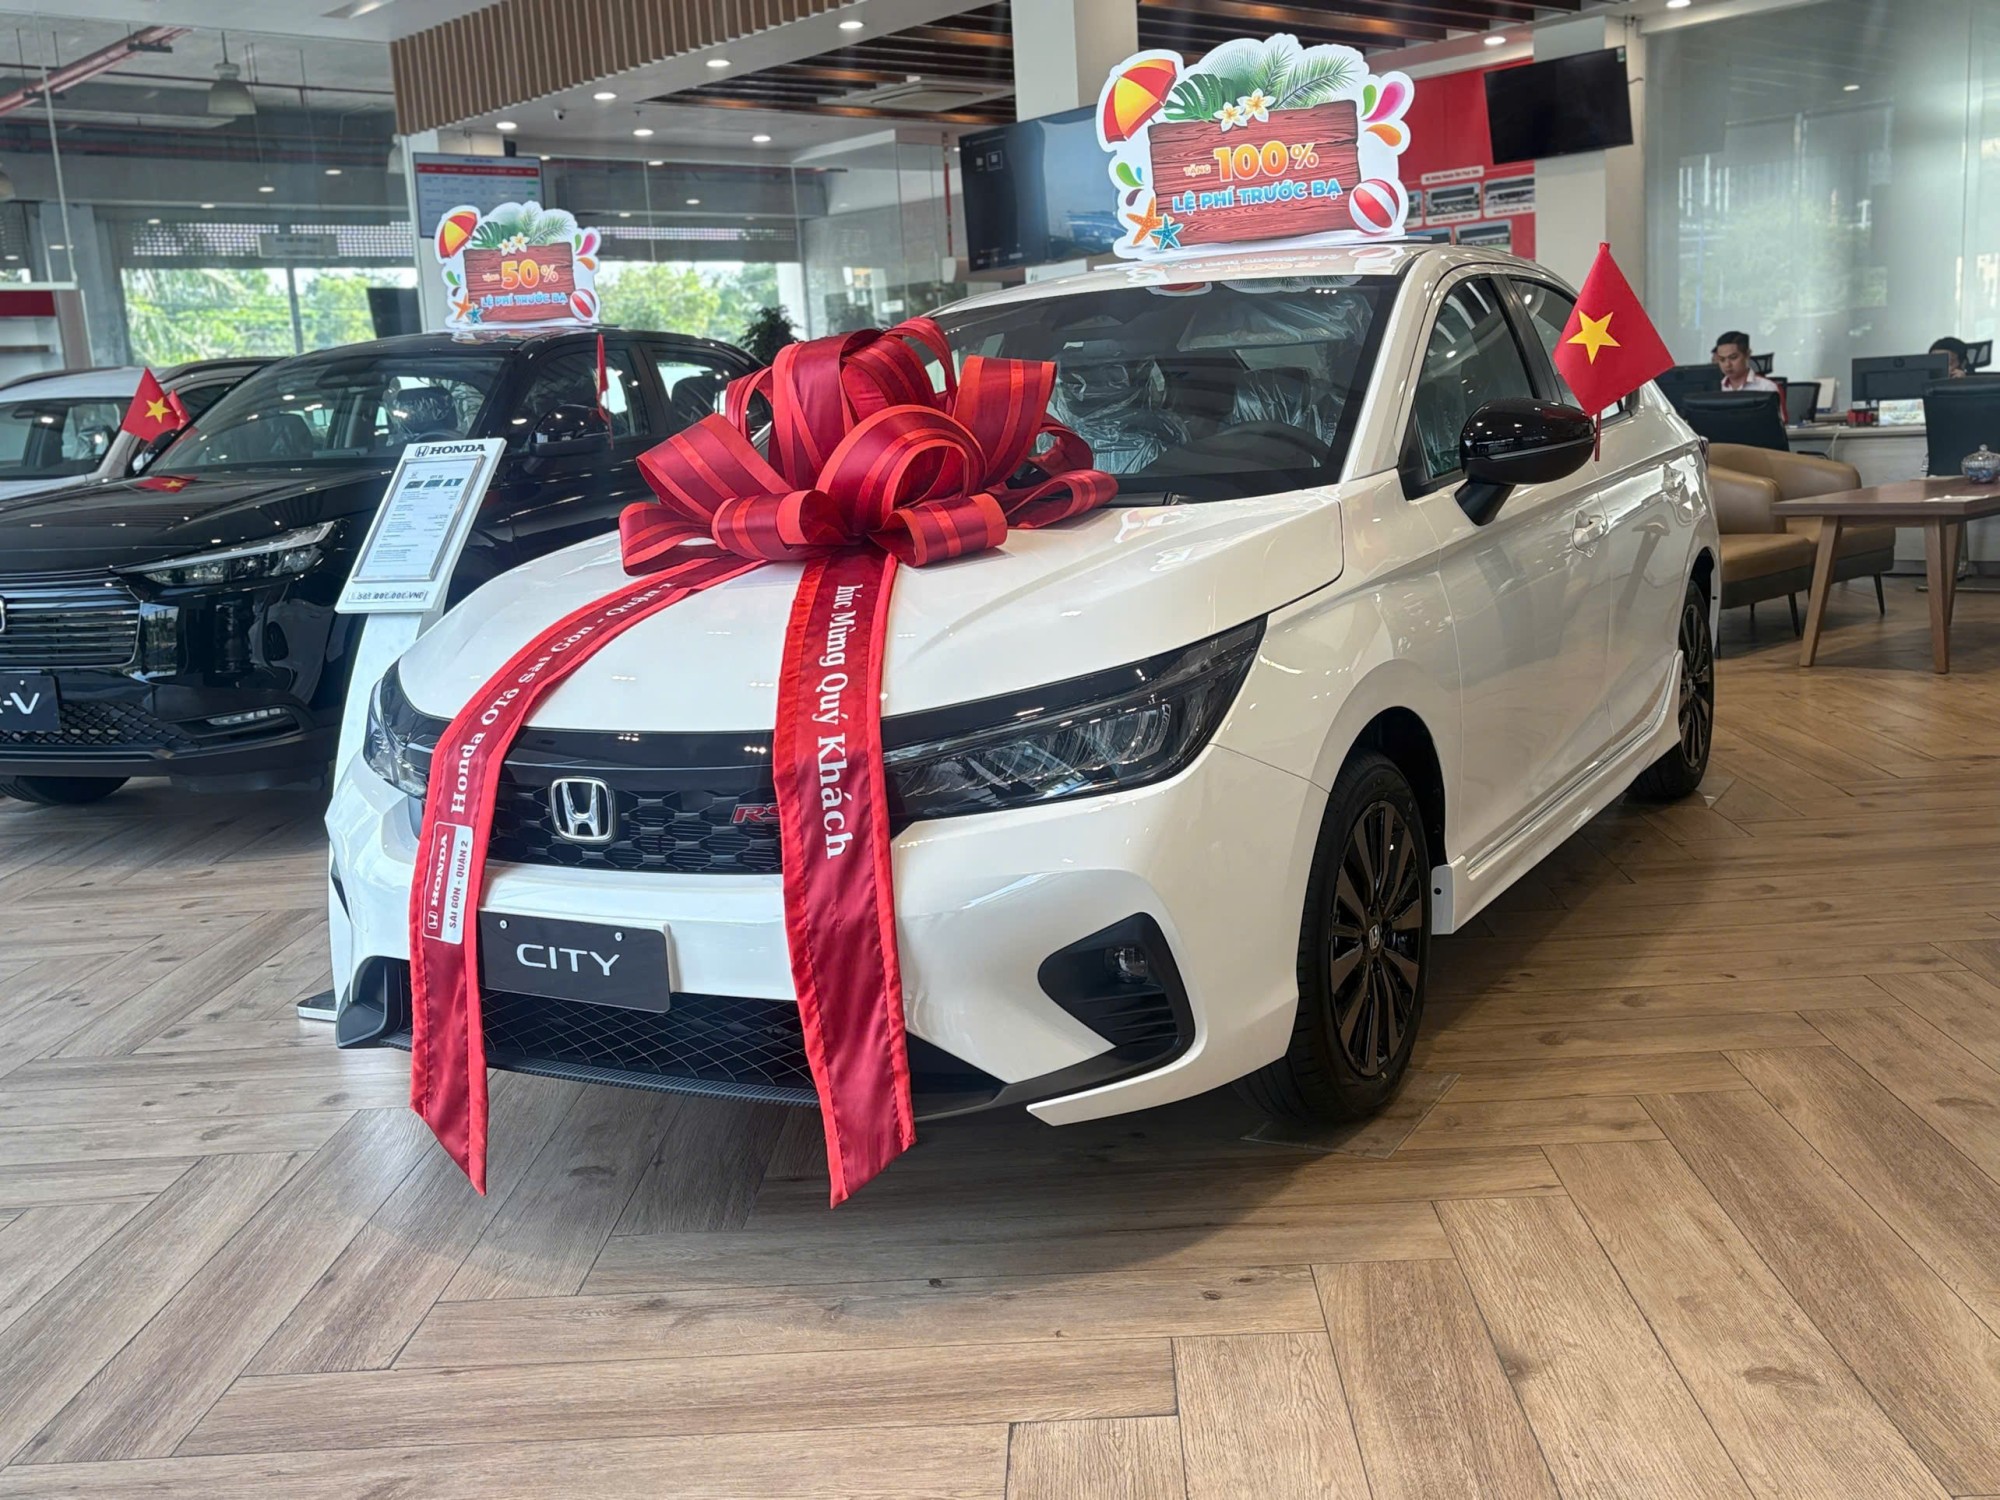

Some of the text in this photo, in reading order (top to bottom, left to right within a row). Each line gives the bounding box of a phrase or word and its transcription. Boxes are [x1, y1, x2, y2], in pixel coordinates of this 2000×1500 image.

[1213, 140, 1320, 182] 100%
[1172, 178, 1343, 215] LỆ PHÍ TRƯỚC BẠ
[501, 258, 559, 290] 50%
[429, 443, 486, 455] HONDA
[0, 692, 40, 715] -V
[451, 732, 487, 814] Honda
[518, 656, 552, 683] Sài
[551, 626, 595, 652] Gòn
[812, 583, 864, 860] húc Mừng Quý Khách
[461, 840, 468, 848] 2
[431, 833, 448, 907] HONDA
[456, 849, 468, 878] QUẬN
[451, 887, 461, 909] GÒN
[449, 911, 458, 929] SÀI
[516, 943, 620, 976] CITY
